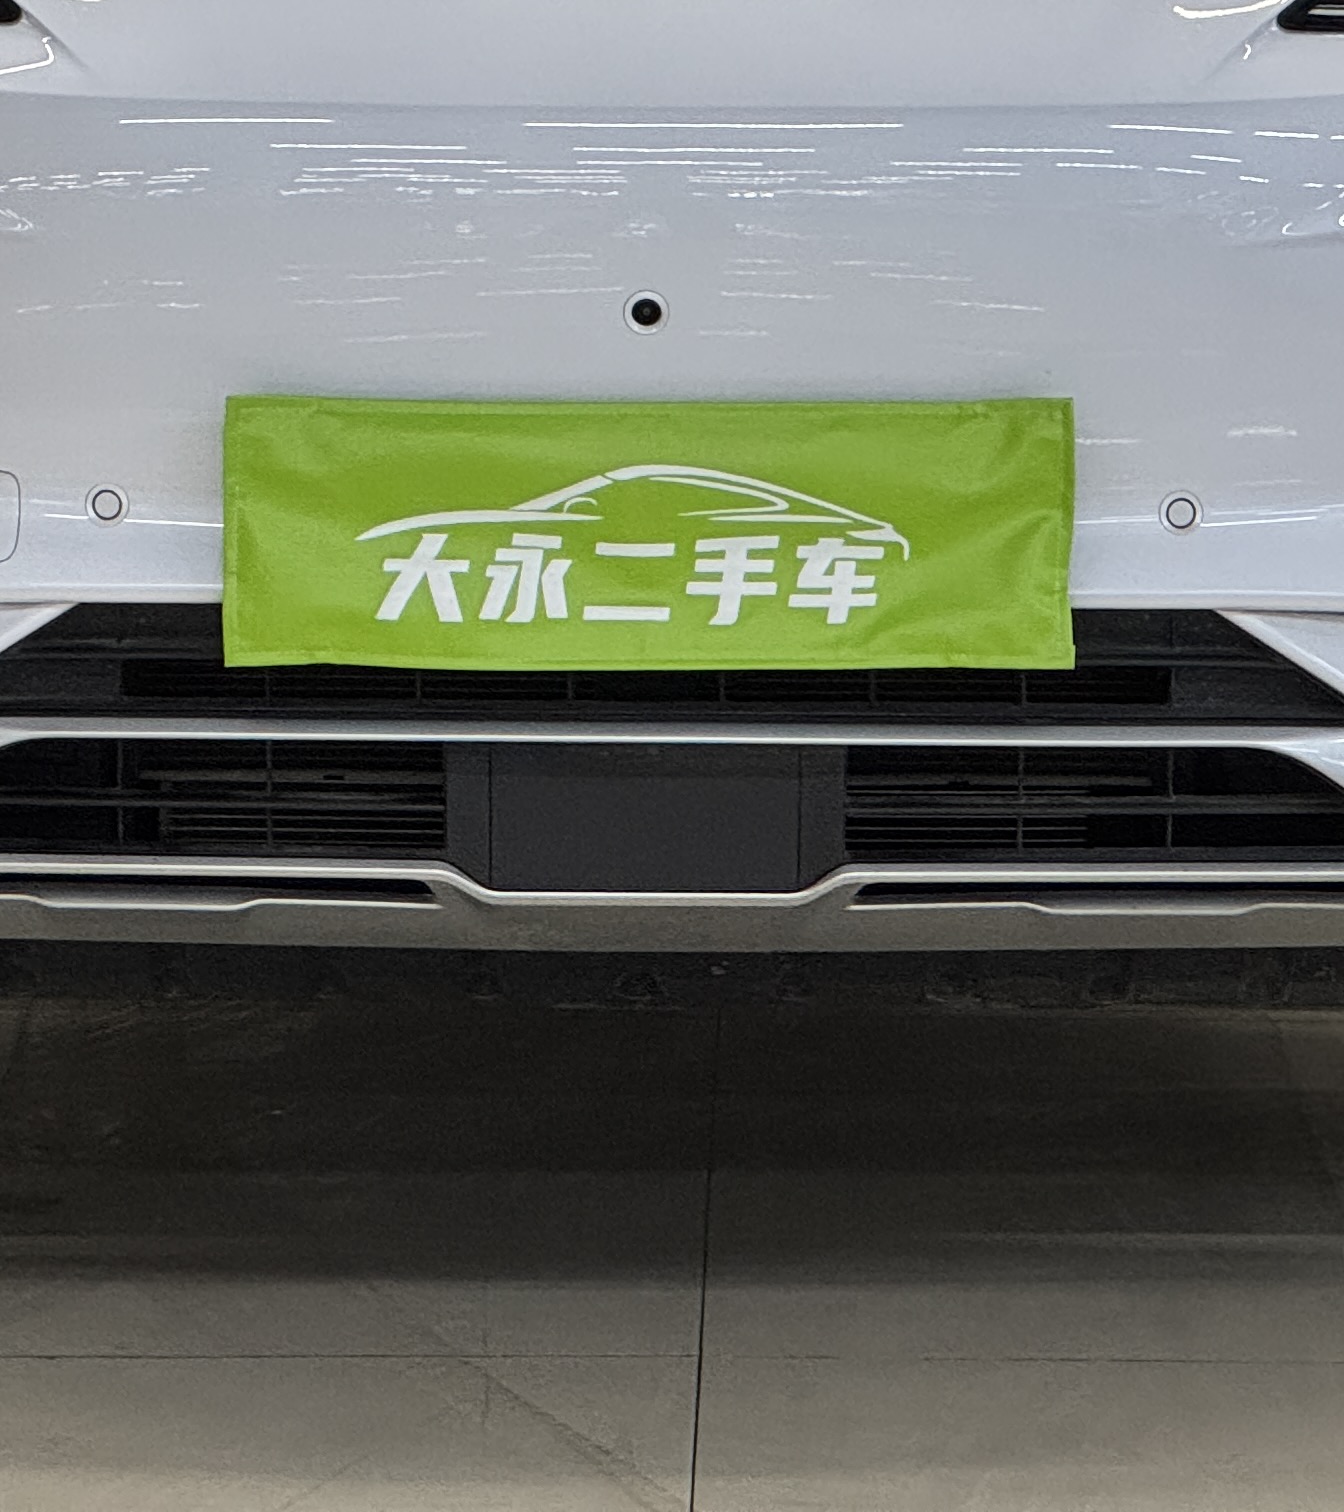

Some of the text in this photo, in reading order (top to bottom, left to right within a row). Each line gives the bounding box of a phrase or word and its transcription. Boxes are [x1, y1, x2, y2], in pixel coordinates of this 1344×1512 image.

[374, 533, 886, 626] 大永二手车
